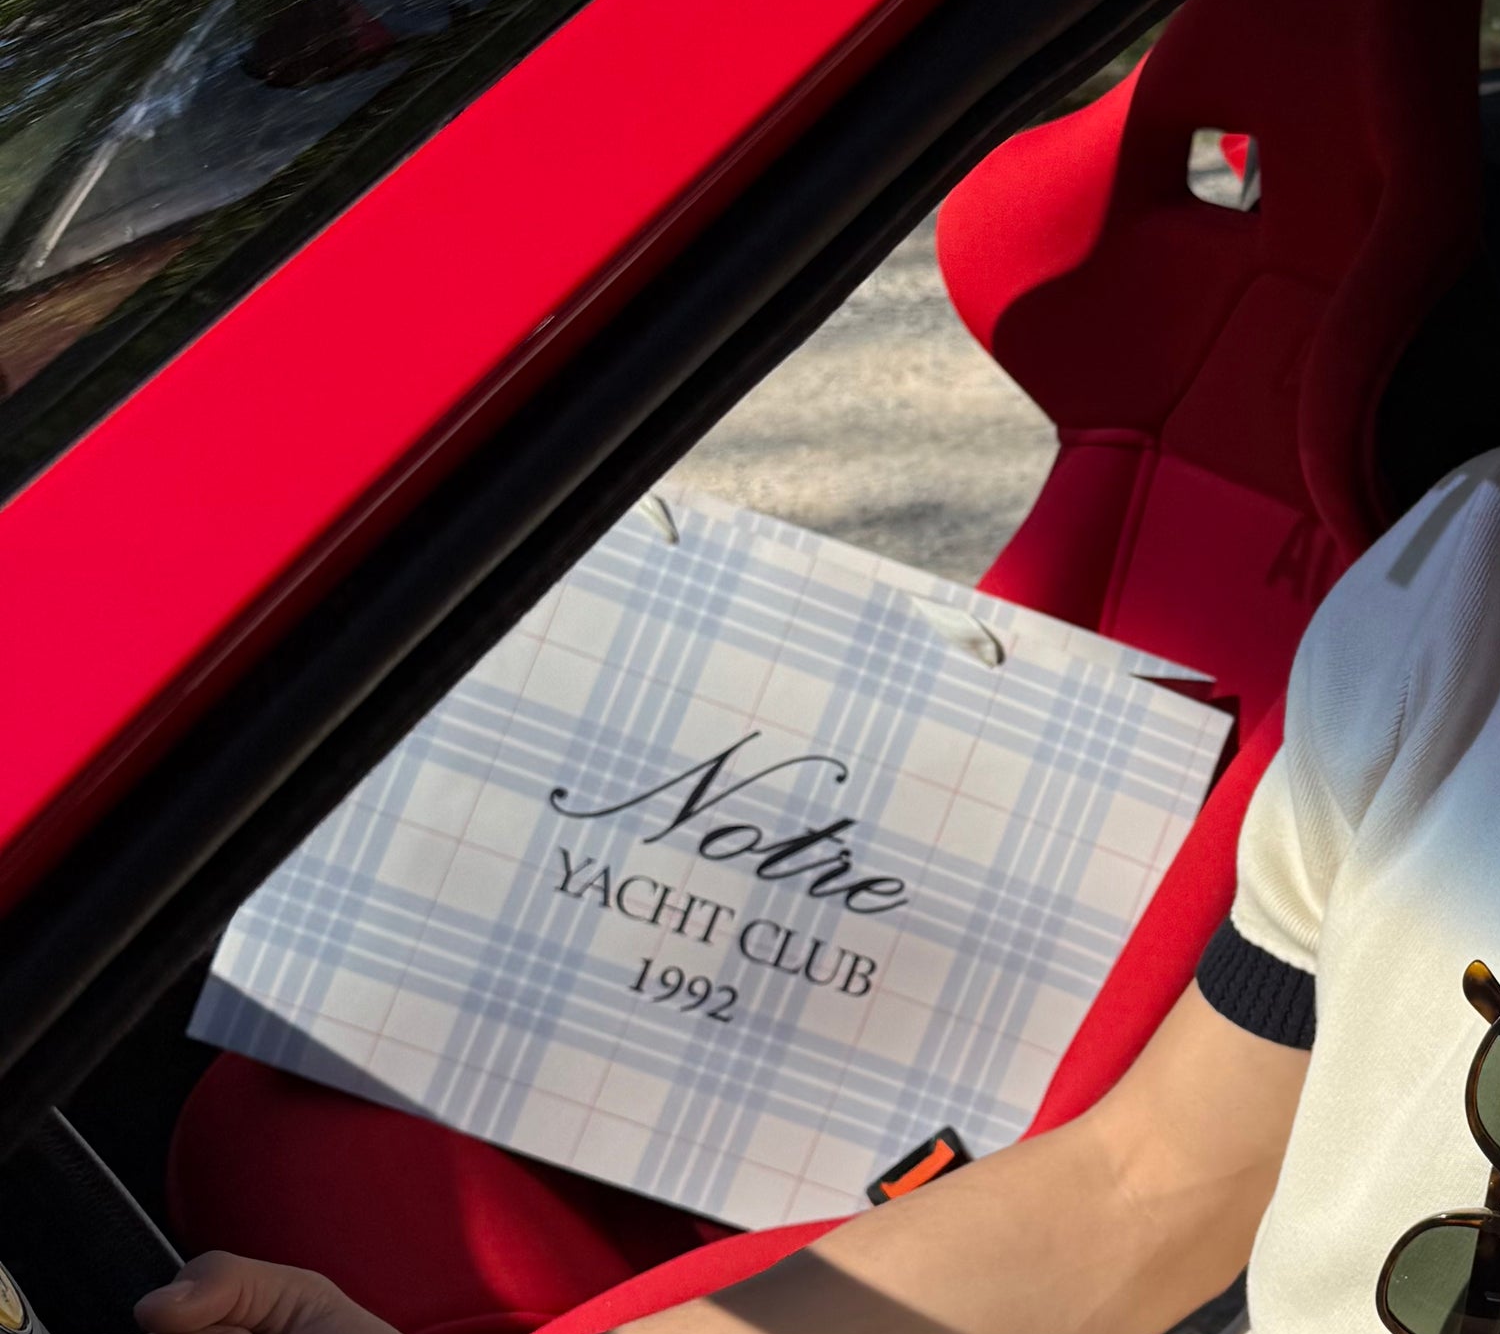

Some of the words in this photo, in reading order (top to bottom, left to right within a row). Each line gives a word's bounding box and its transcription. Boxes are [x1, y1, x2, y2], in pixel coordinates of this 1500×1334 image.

[548, 730, 908, 916] Notre
[552, 847, 736, 945] YACHT
[737, 918, 879, 998] CLUB
[627, 956, 740, 1024] 1992
